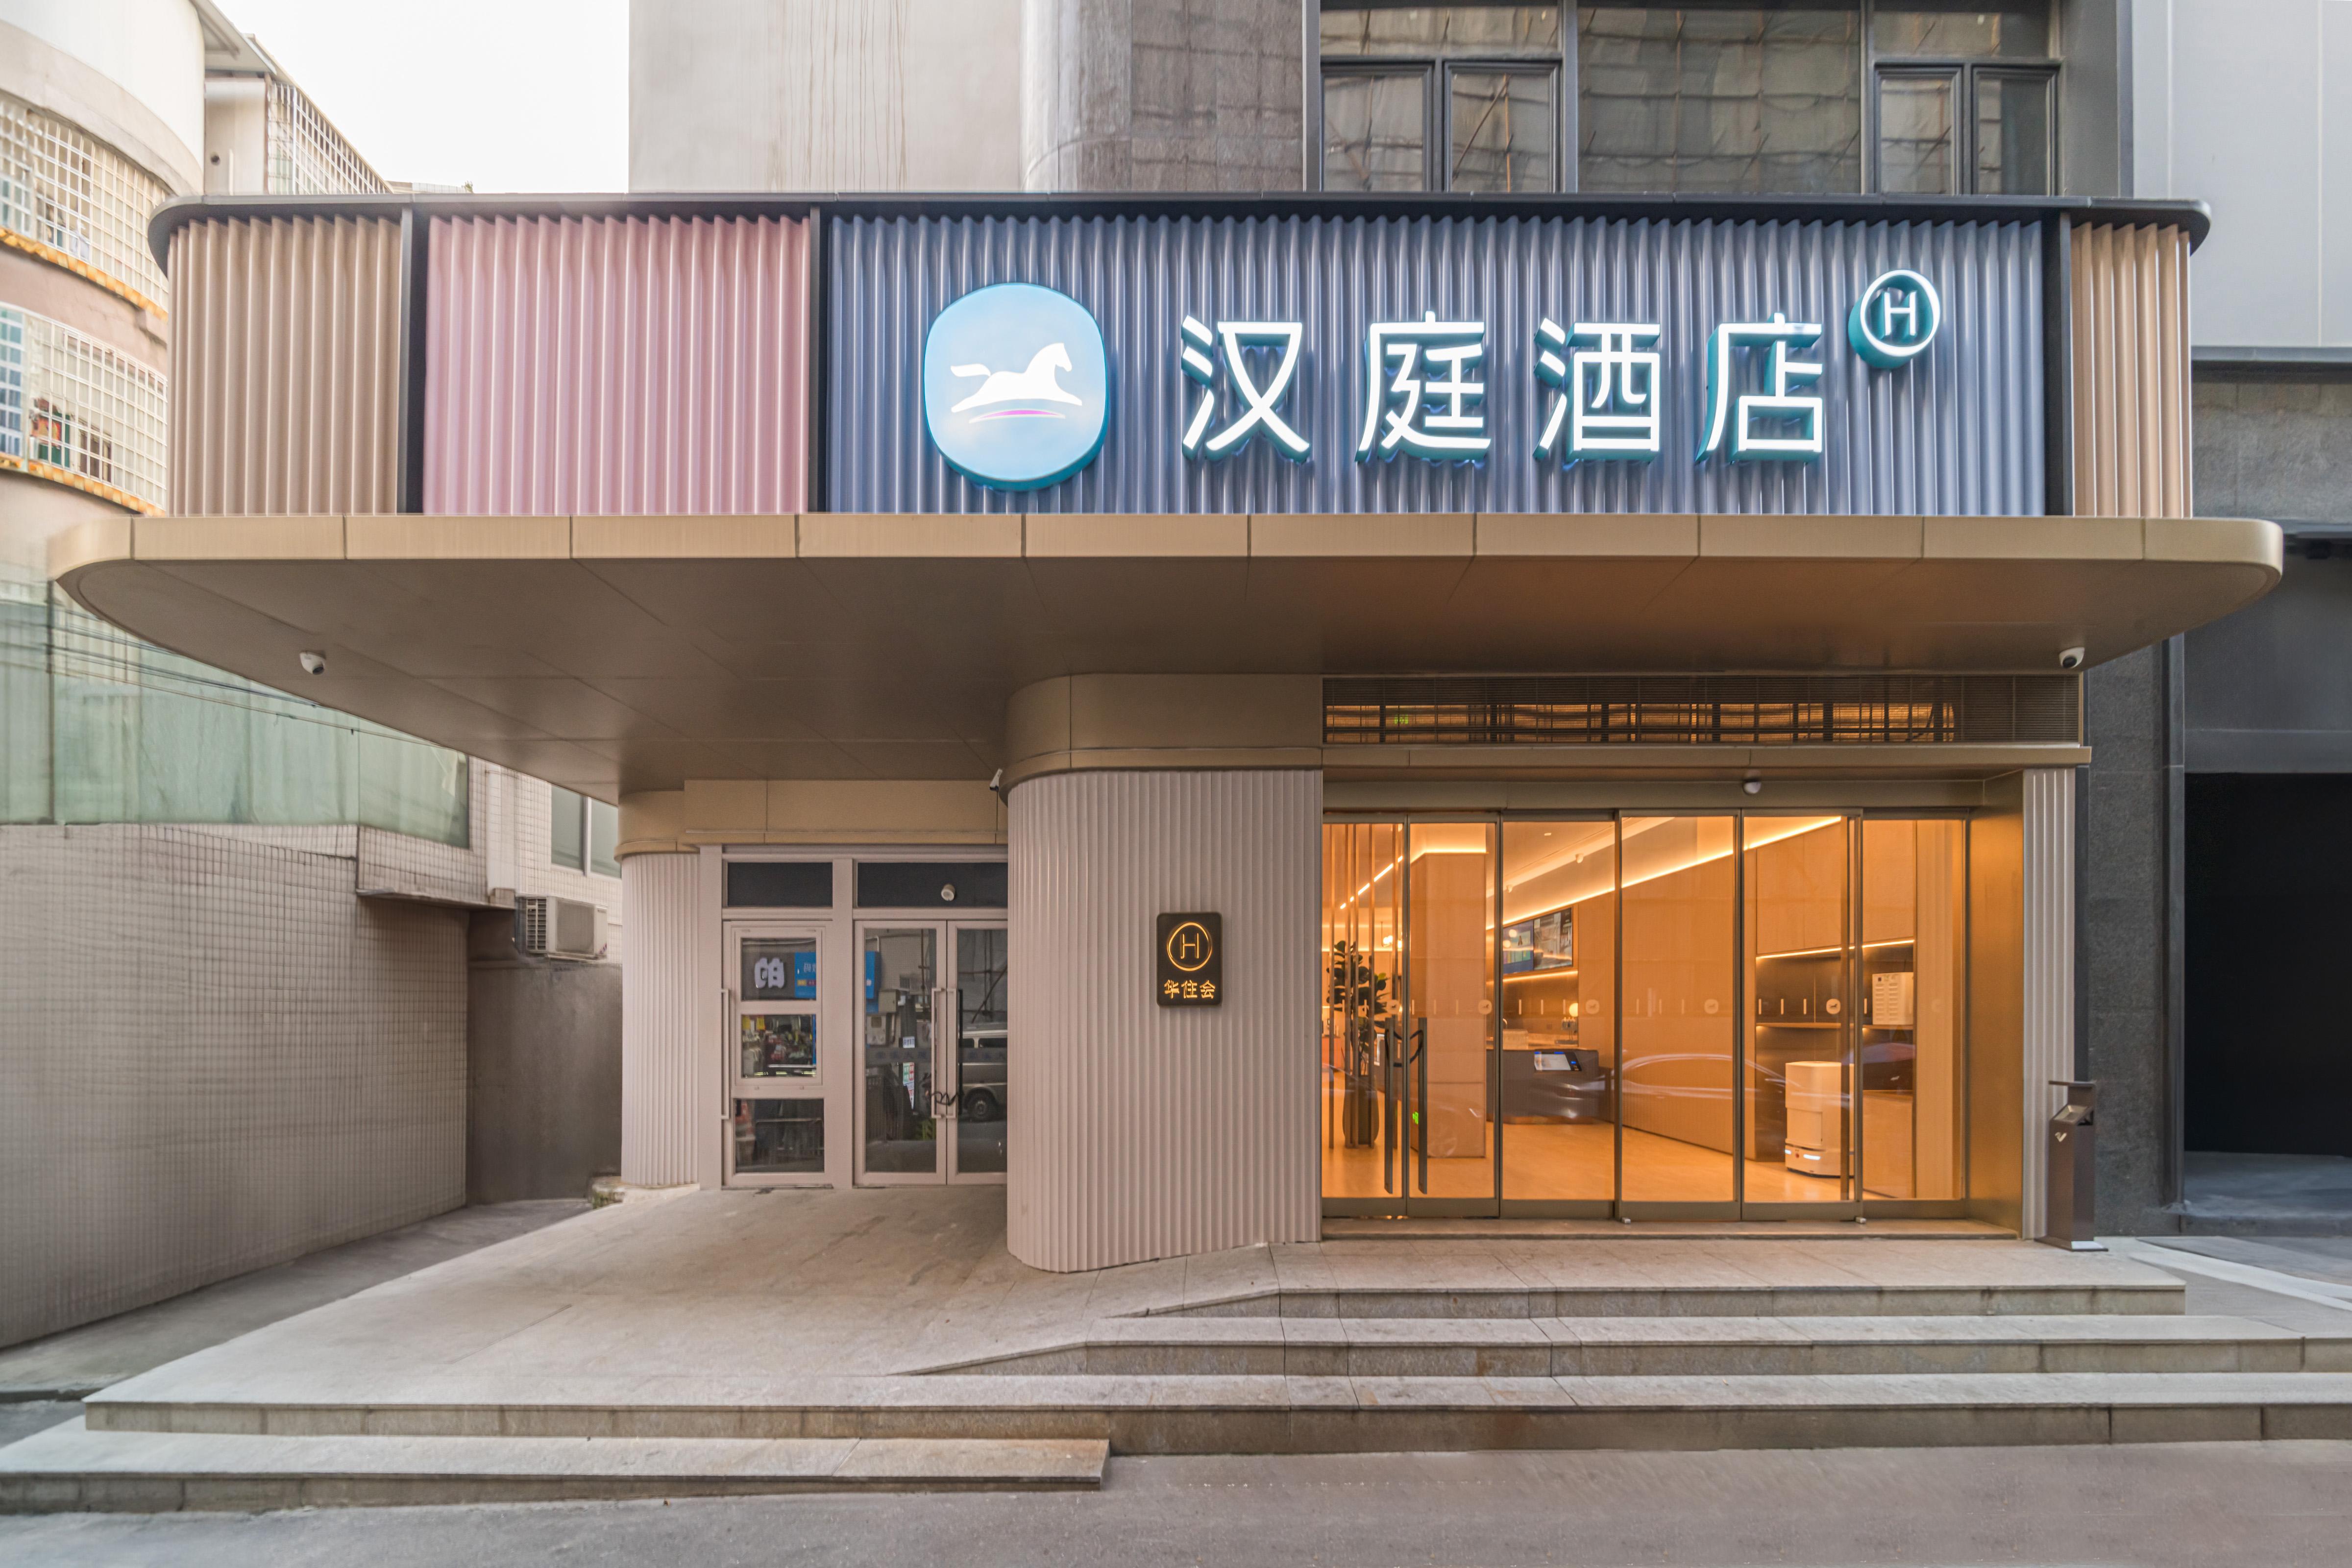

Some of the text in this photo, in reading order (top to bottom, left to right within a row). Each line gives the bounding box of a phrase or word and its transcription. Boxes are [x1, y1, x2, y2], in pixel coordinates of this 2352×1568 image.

[1181, 311, 1823, 457] 汉庭酒店
[1164, 979, 1216, 999] 华住会
